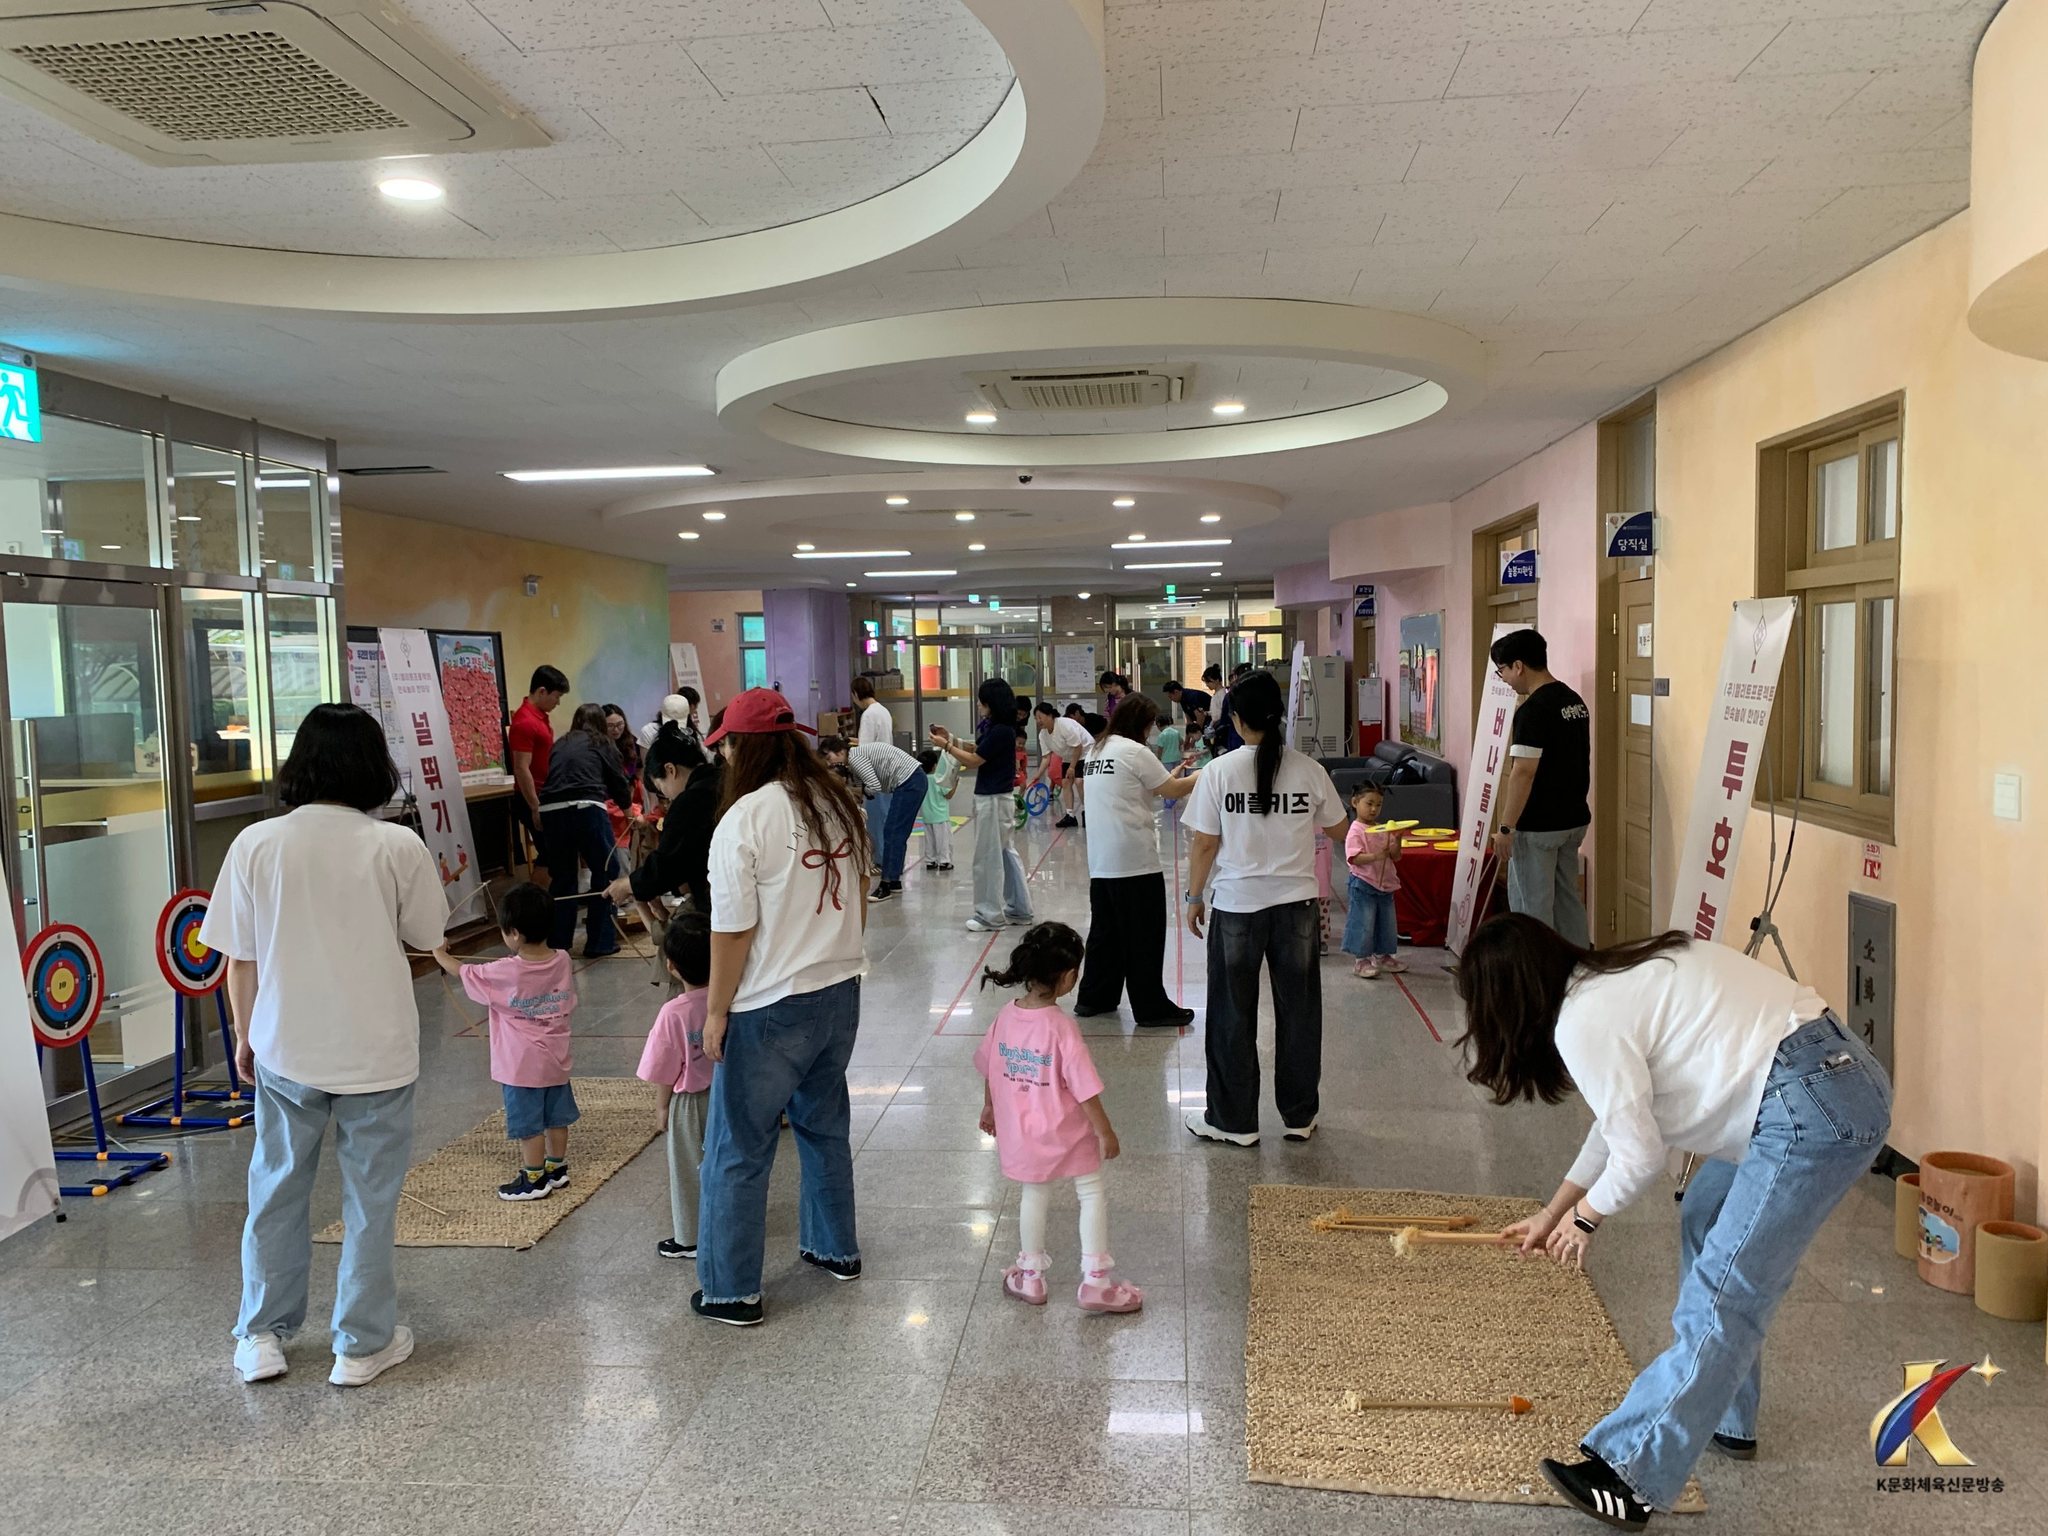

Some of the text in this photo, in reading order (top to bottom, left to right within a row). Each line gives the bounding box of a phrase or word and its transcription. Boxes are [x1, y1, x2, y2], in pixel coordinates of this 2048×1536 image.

[1617, 538, 1648, 551] 당직실
[1724, 705, 1766, 727] 민속놀이 한마당
[411, 711, 452, 834] 널뛰기
[1225, 792, 1309, 815] 애플키즈
[1863, 938, 1876, 1045] 소화기
